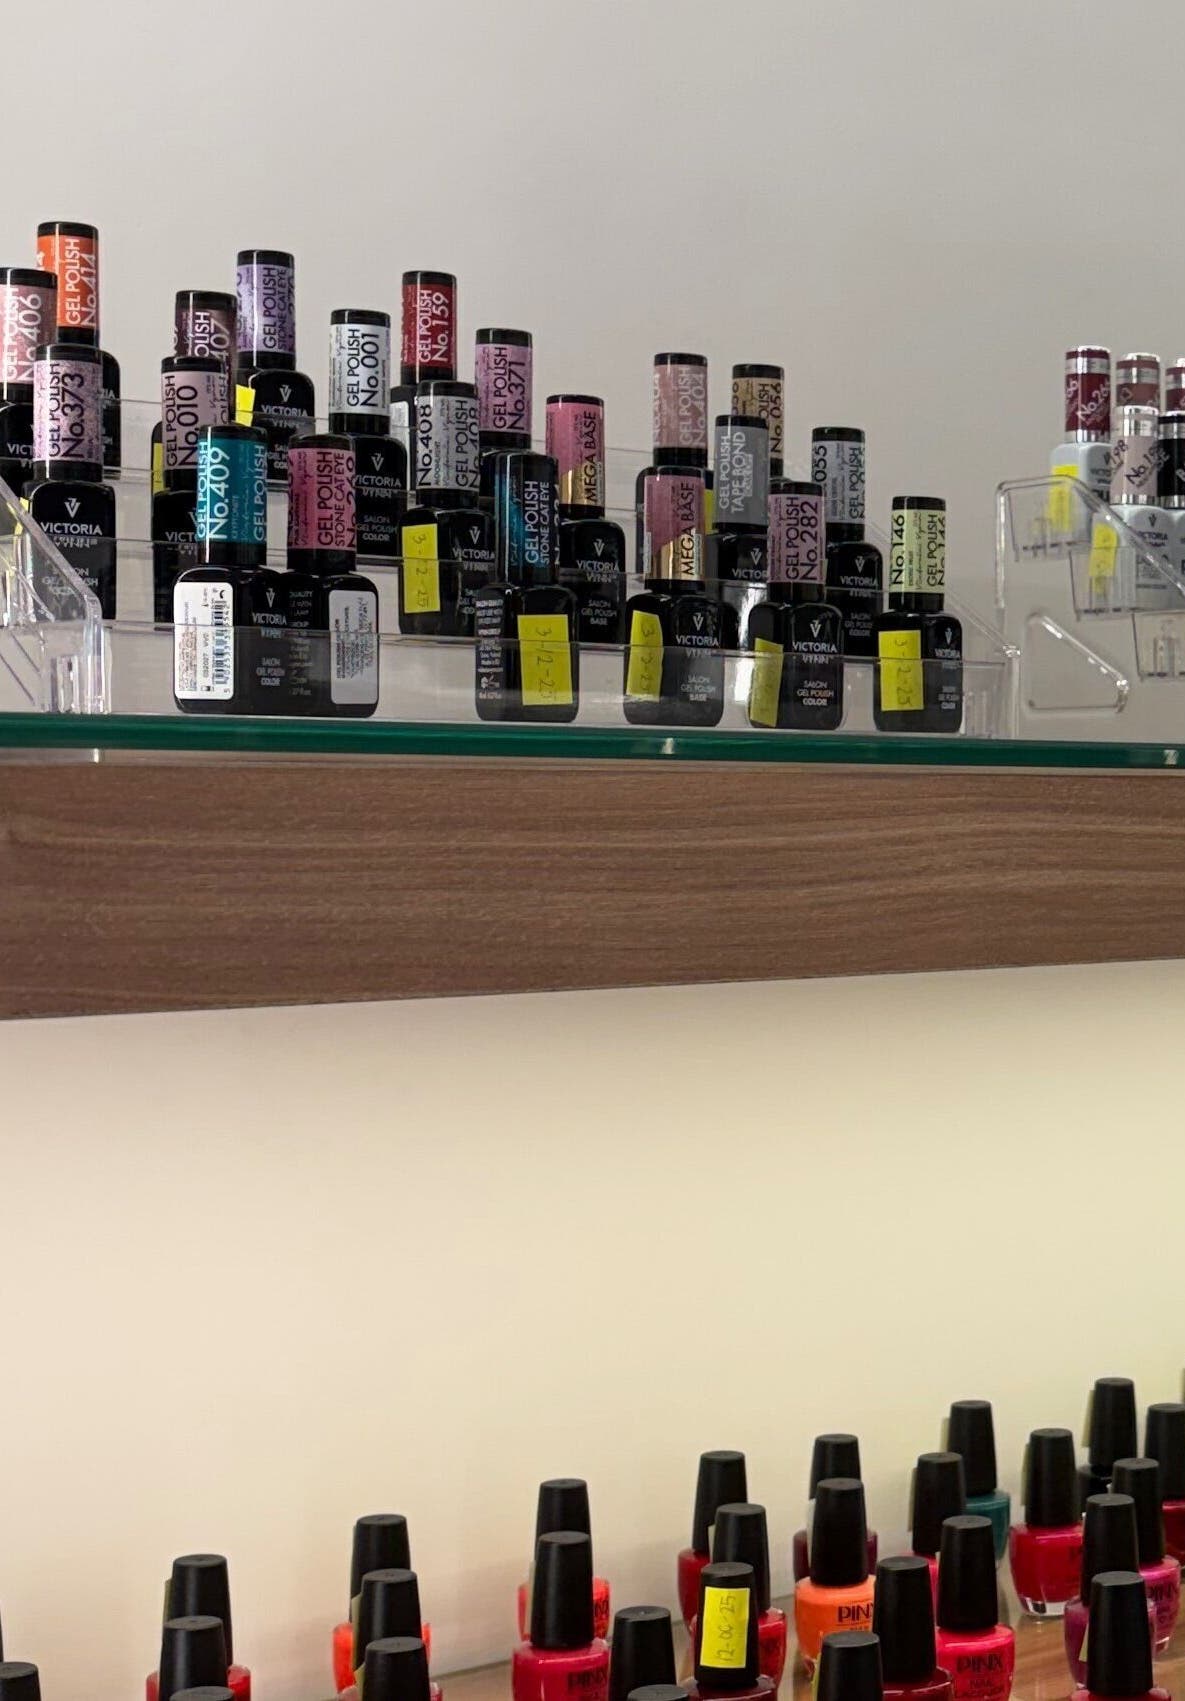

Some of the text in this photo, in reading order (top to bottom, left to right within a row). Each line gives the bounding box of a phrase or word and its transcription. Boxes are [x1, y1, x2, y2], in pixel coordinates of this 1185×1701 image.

[65, 238, 80, 324] GEL POLISH
[263, 267, 276, 348] GEL POLISH
[277, 268, 288, 288] EYE
[18, 294, 41, 381] No406
[195, 311, 209, 357] OLISH
[277, 313, 288, 350] STONE
[418, 289, 431, 362] GEL POLISH
[432, 292, 449, 362] No.159
[347, 329, 360, 406] GEL POLISH
[361, 333, 380, 407] No.001
[493, 347, 507, 429] GEL POLISH
[508, 361, 526, 430] No.371
[679, 367, 692, 444] GEL POLISH
[758, 383, 769, 418] OLISH
[61, 373, 84, 458] No.373
[165, 375, 177, 467] GEL POLISH
[176, 386, 199, 467] No.010
[261, 405, 308, 417] VICTORIA
[418, 404, 433, 486] No.408
[455, 400, 468, 486] GEL POLISH
[197, 442, 208, 538] GEL POLISH
[209, 447, 230, 539] No.409
[254, 445, 266, 541] GEL POLISH
[584, 411, 597, 504] MEGA BASE
[719, 436, 731, 509] GEL POLISH
[732, 432, 746, 512] TAPE BOND
[849, 447, 860, 519] GEL POLISH
[40, 522, 102, 535] VICTORIA
[317, 451, 333, 545] GEL POLISH
[334, 453, 345, 546] STONE CAT EYE
[525, 481, 538, 563] GEL POLISH
[540, 482, 549, 564] STONE CAT EYE
[681, 483, 695, 576] MEGA BASE
[576, 560, 619, 571] VICTORIA
[732, 569, 767, 579] VICTOR
[786, 496, 800, 580] GEL POLISH
[801, 501, 818, 581] No.282
[892, 514, 905, 585] No.146
[927, 514, 938, 587] GEL POLISH
[252, 612, 288, 625] VICTORIA
[675, 635, 720, 647] VICTORIA
[793, 641, 838, 653] VICTORIA
[803, 698, 828, 706] COLOR
